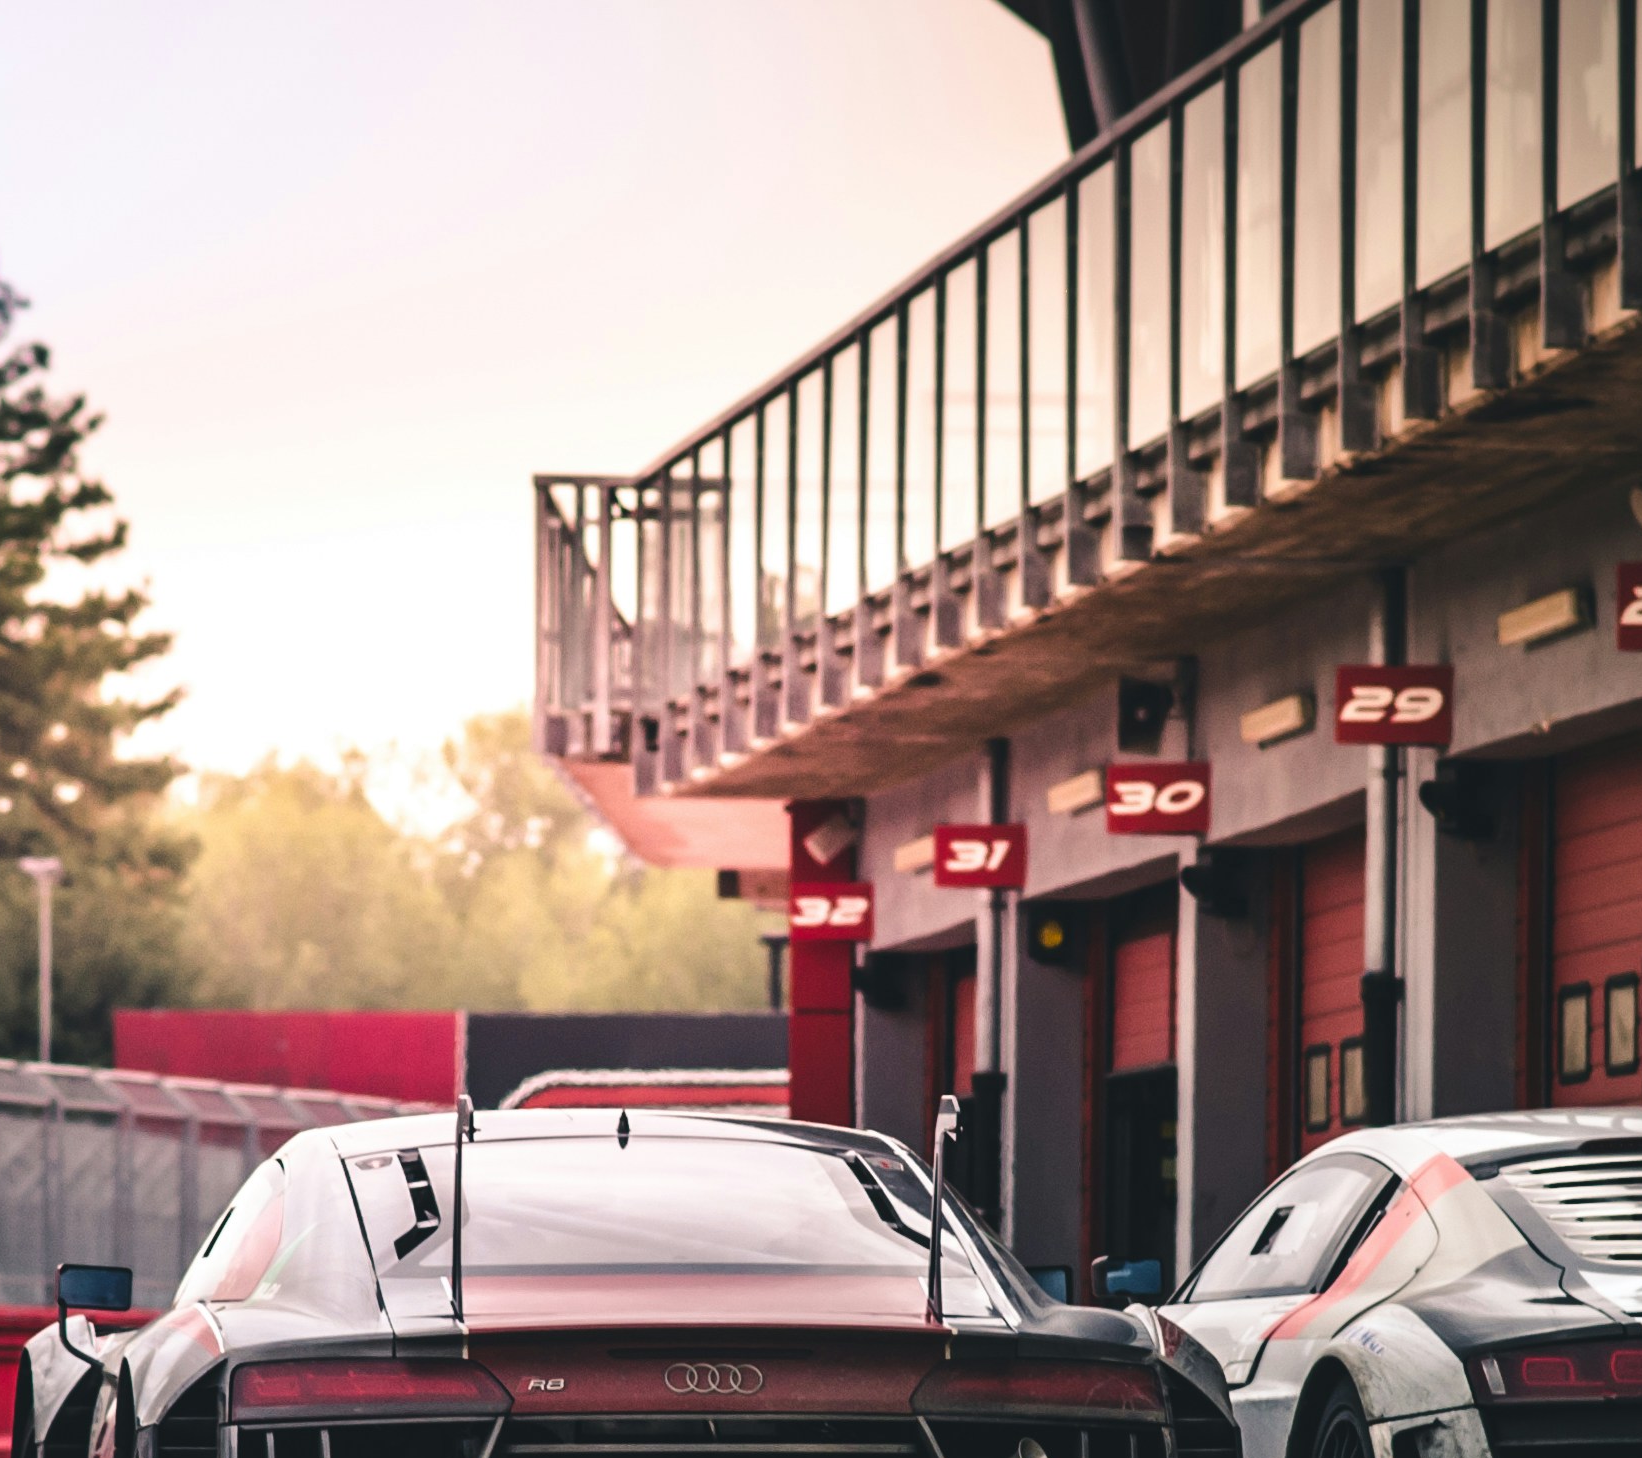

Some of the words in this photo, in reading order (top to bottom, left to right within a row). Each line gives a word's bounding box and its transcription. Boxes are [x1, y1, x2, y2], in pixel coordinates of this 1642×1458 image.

[1340, 685, 1444, 722] 29
[1109, 780, 1205, 815] 30
[945, 839, 1010, 872] 31
[791, 896, 869, 927] 32
[528, 1378, 565, 1391] R8
